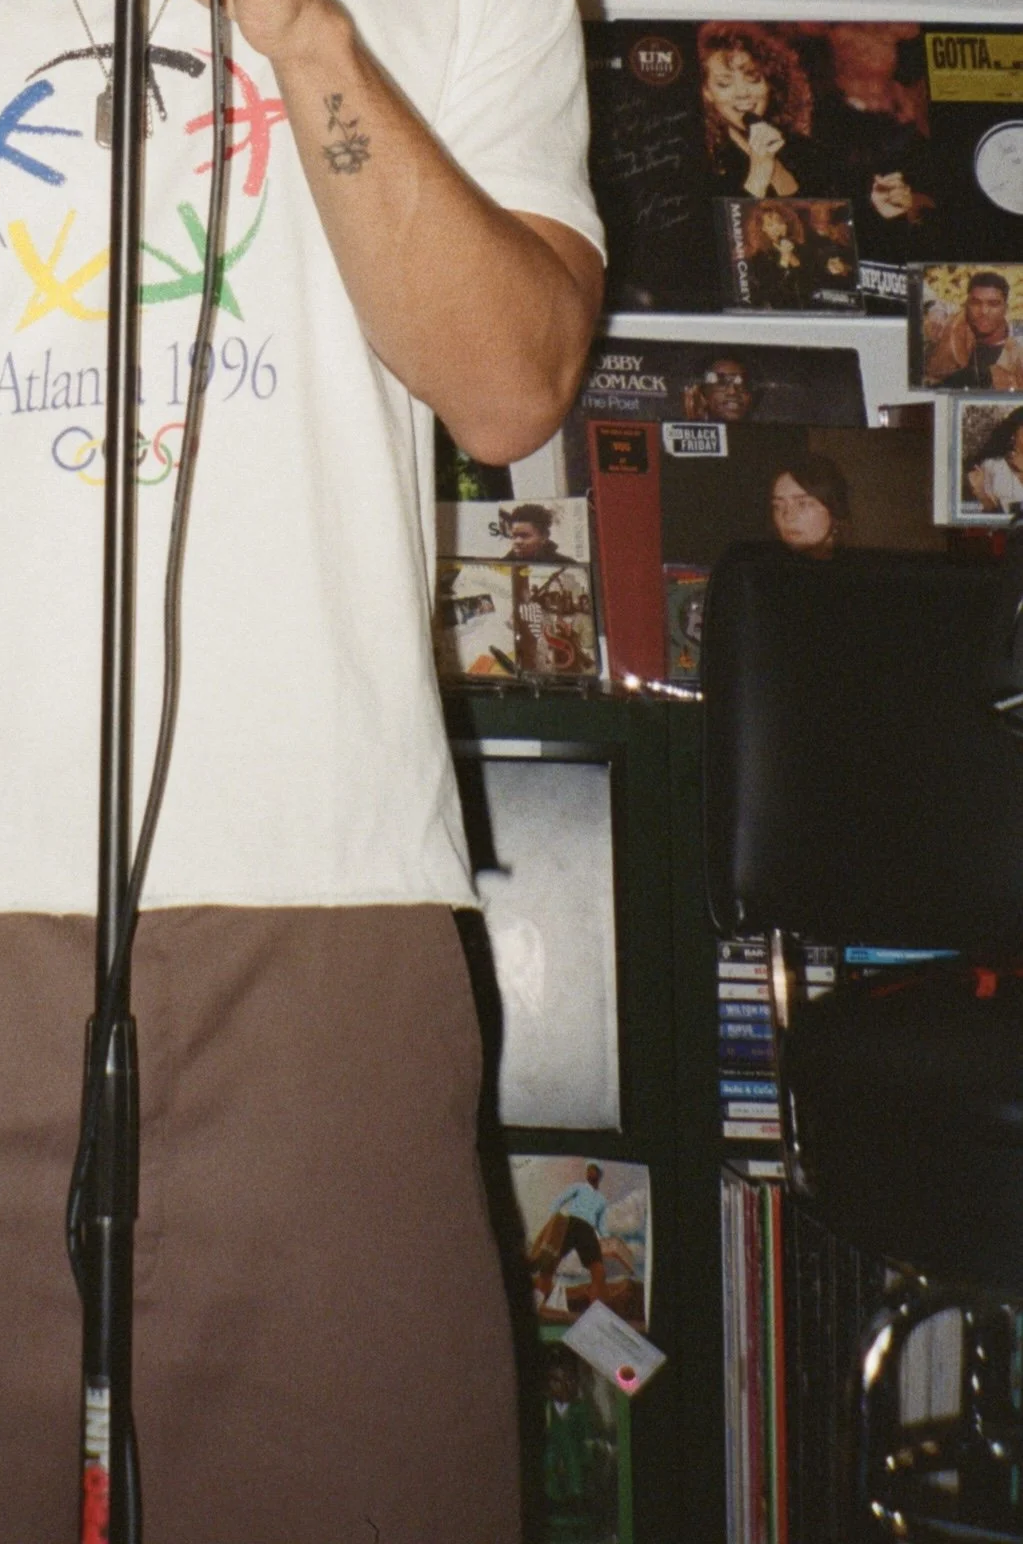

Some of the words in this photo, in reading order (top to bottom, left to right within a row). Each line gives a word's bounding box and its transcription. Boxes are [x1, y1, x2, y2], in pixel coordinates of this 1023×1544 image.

[932, 37, 992, 69] GOTTA
[729, 202, 745, 259] MARIAH
[737, 259, 751, 304] CAREY
[681, 439, 718, 452] FRIDAY
[682, 428, 718, 441] BLACK
